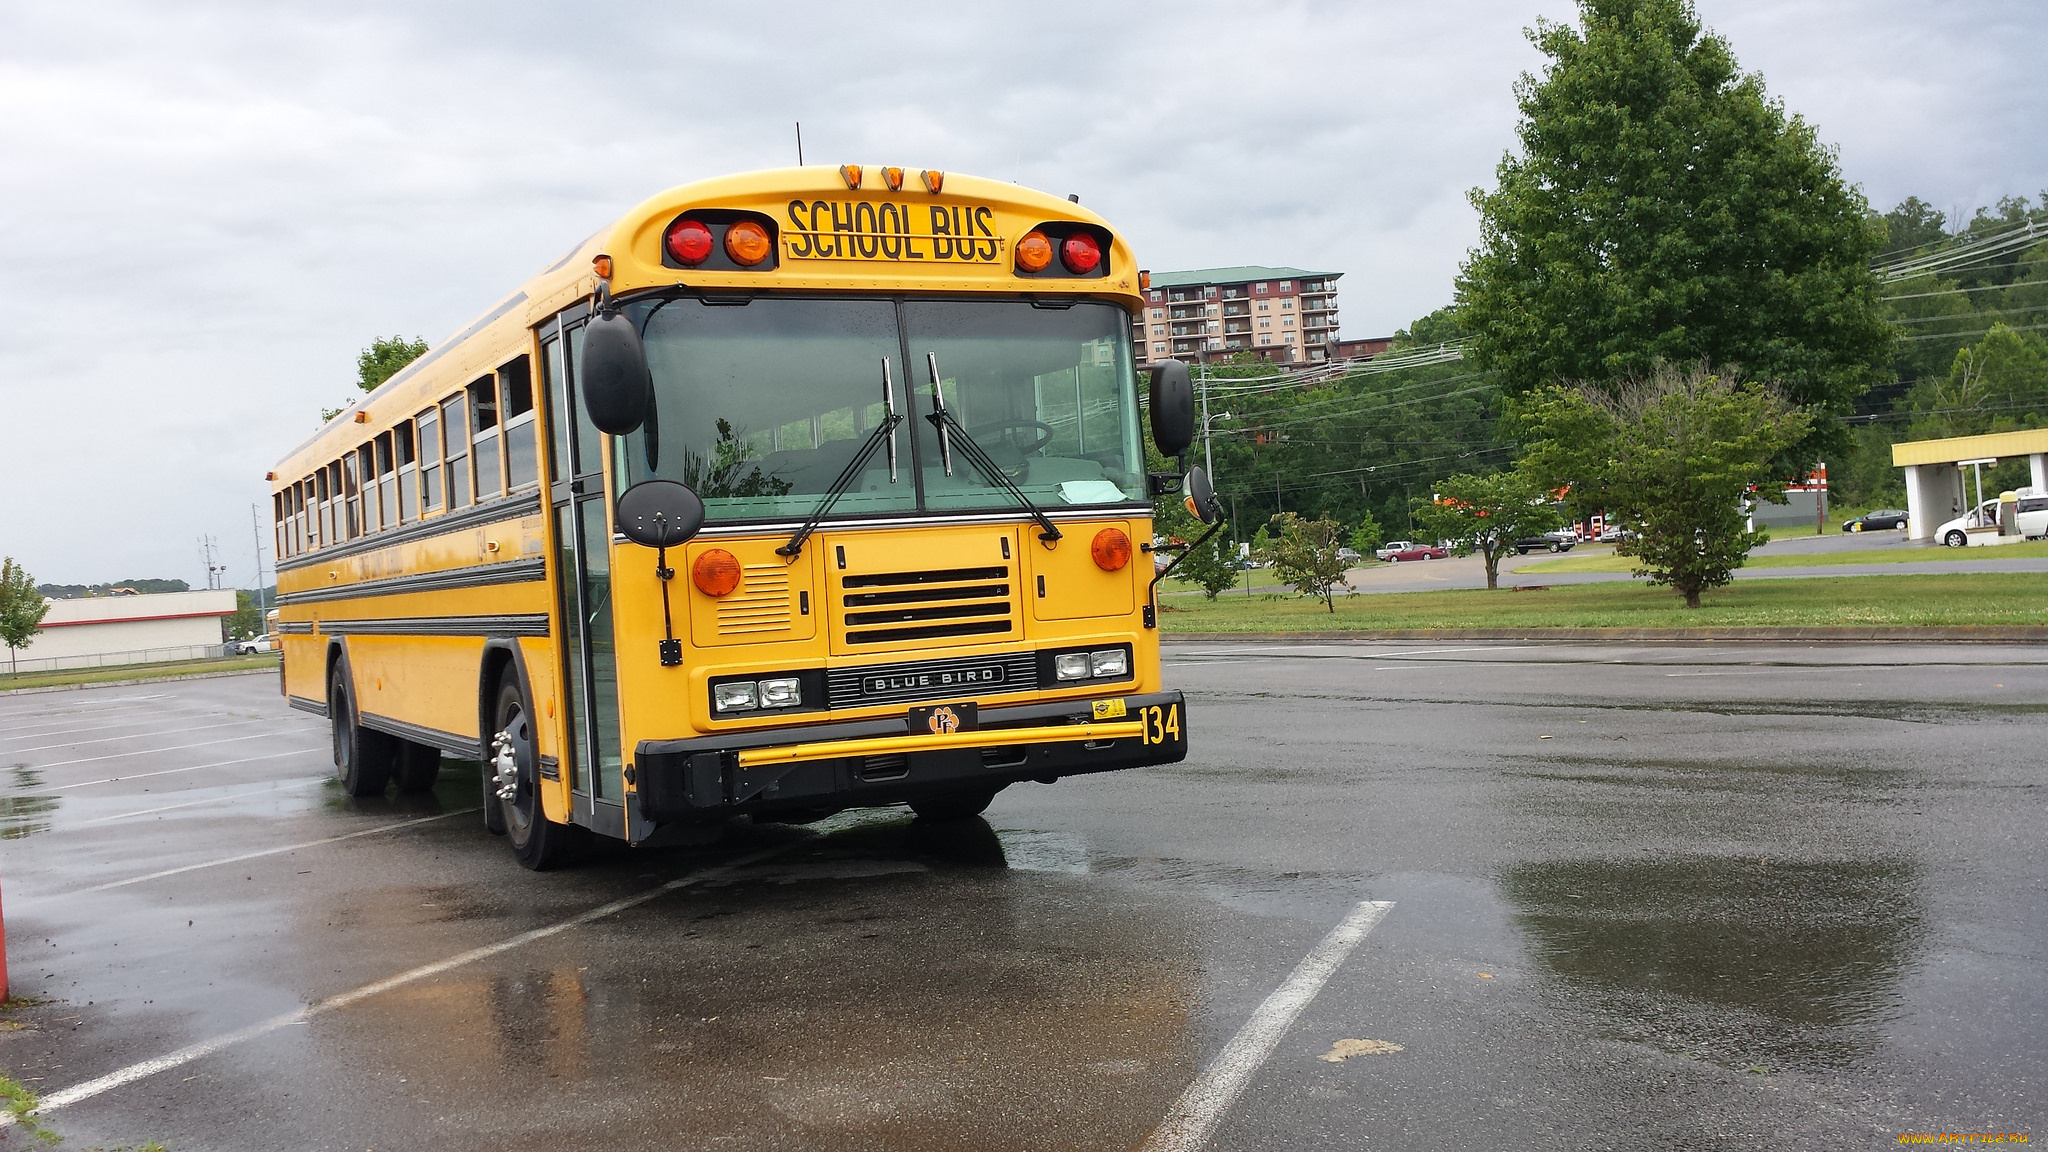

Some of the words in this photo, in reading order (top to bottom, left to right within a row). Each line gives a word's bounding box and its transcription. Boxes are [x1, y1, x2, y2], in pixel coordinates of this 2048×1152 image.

[788, 200, 924, 260] SCHOOL
[930, 205, 997, 261] BUS
[875, 676, 930, 690] BLUE
[942, 669, 993, 684] BIRD
[1139, 703, 1180, 745] 134
